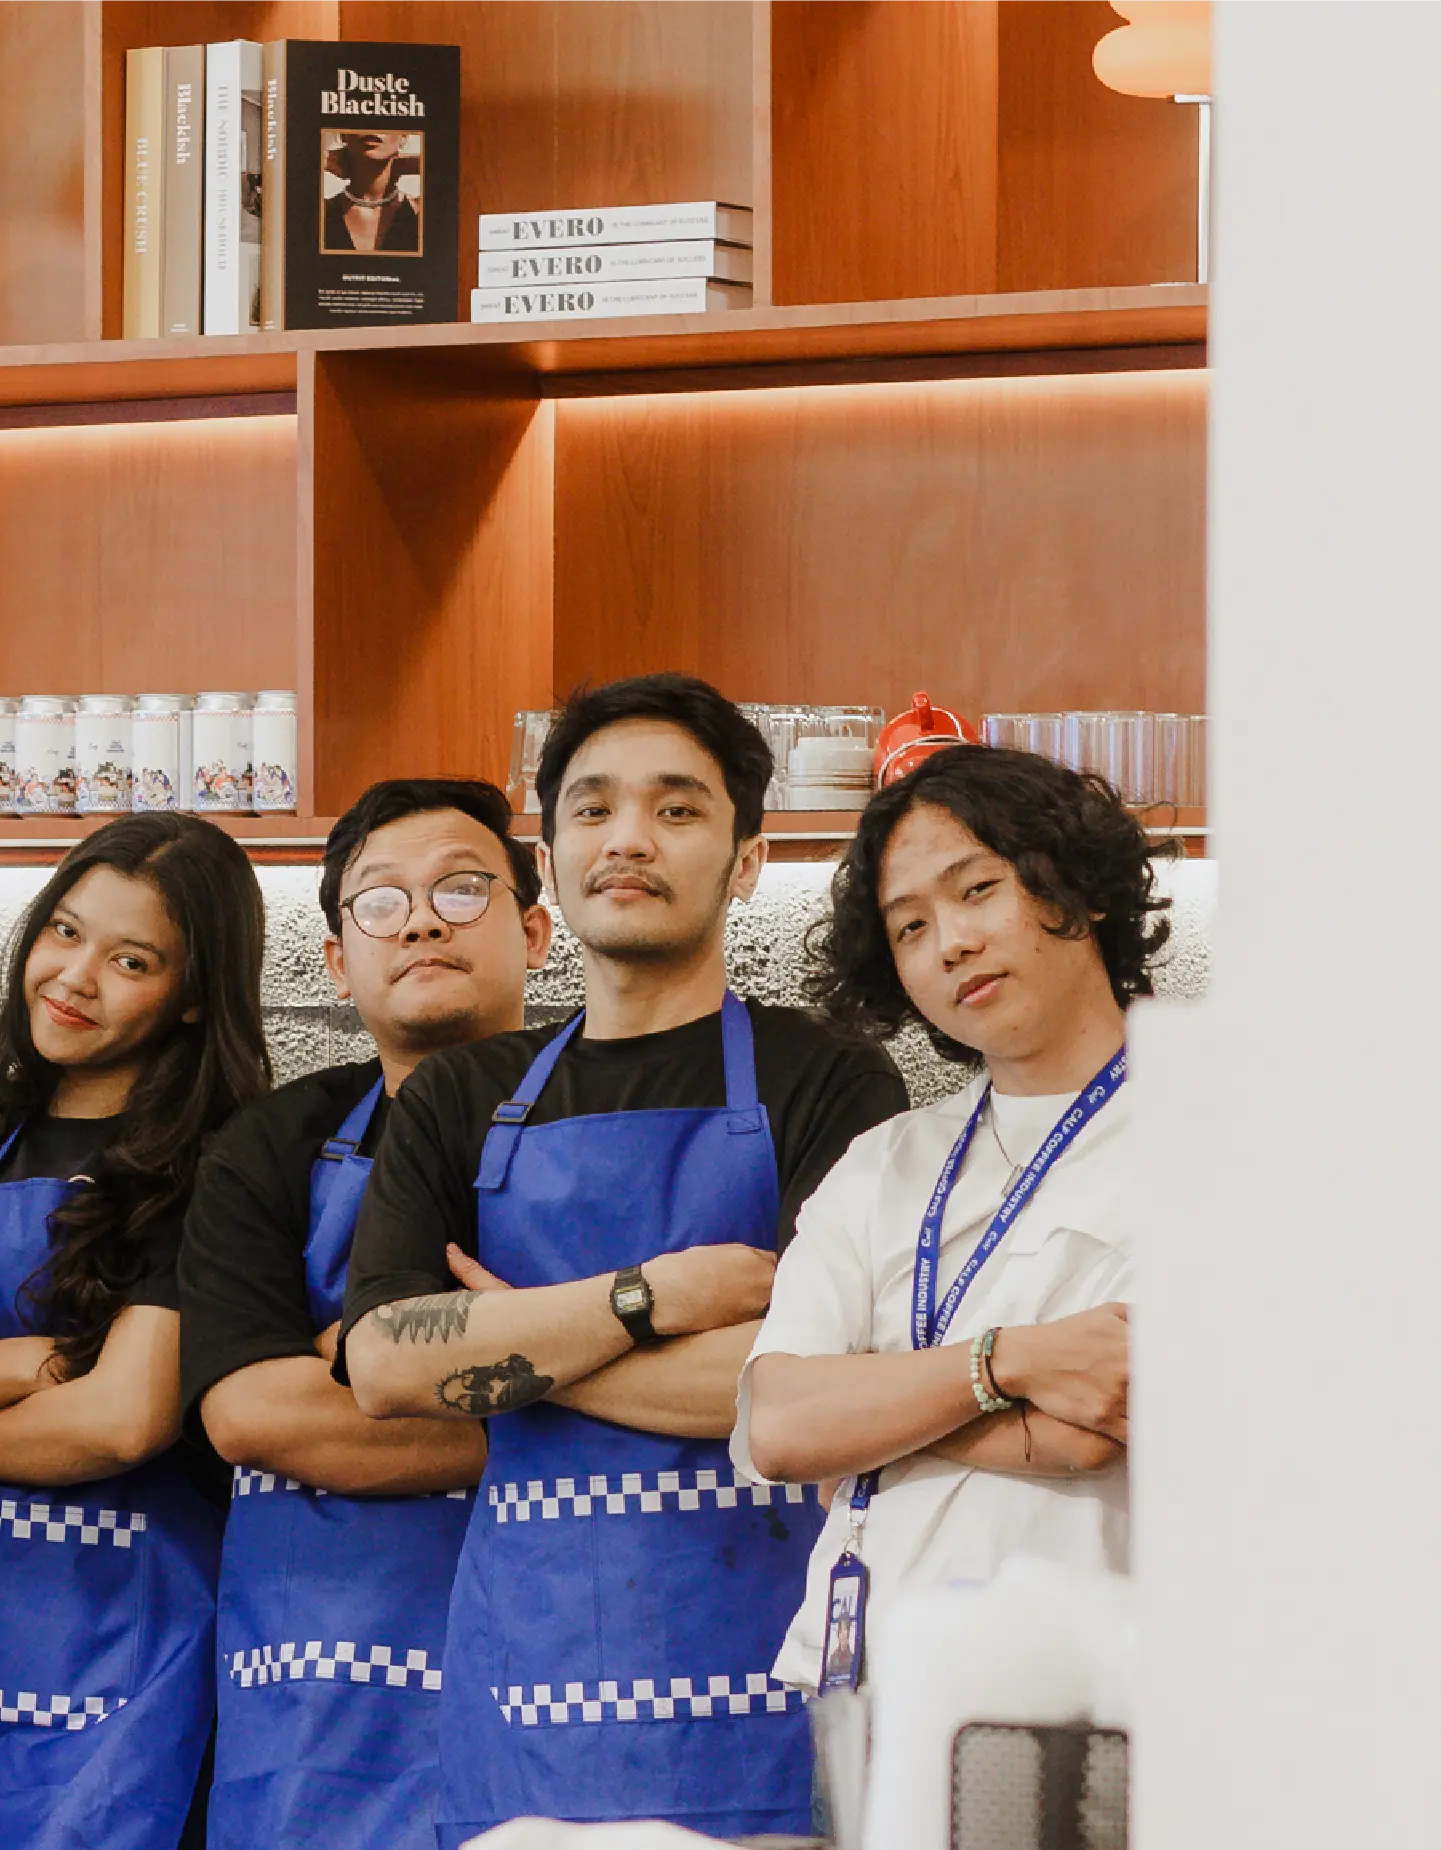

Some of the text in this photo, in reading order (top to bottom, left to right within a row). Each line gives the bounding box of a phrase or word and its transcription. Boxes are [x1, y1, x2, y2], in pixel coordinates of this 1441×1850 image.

[337, 68, 410, 93] Duste
[320, 90, 426, 117] Blackish
[176, 84, 192, 164] Blackish
[512, 217, 605, 240] EVERO
[511, 255, 602, 278] EVERO
[503, 292, 595, 314] EVERO
[917, 1258, 931, 1312] INDUSTRY
